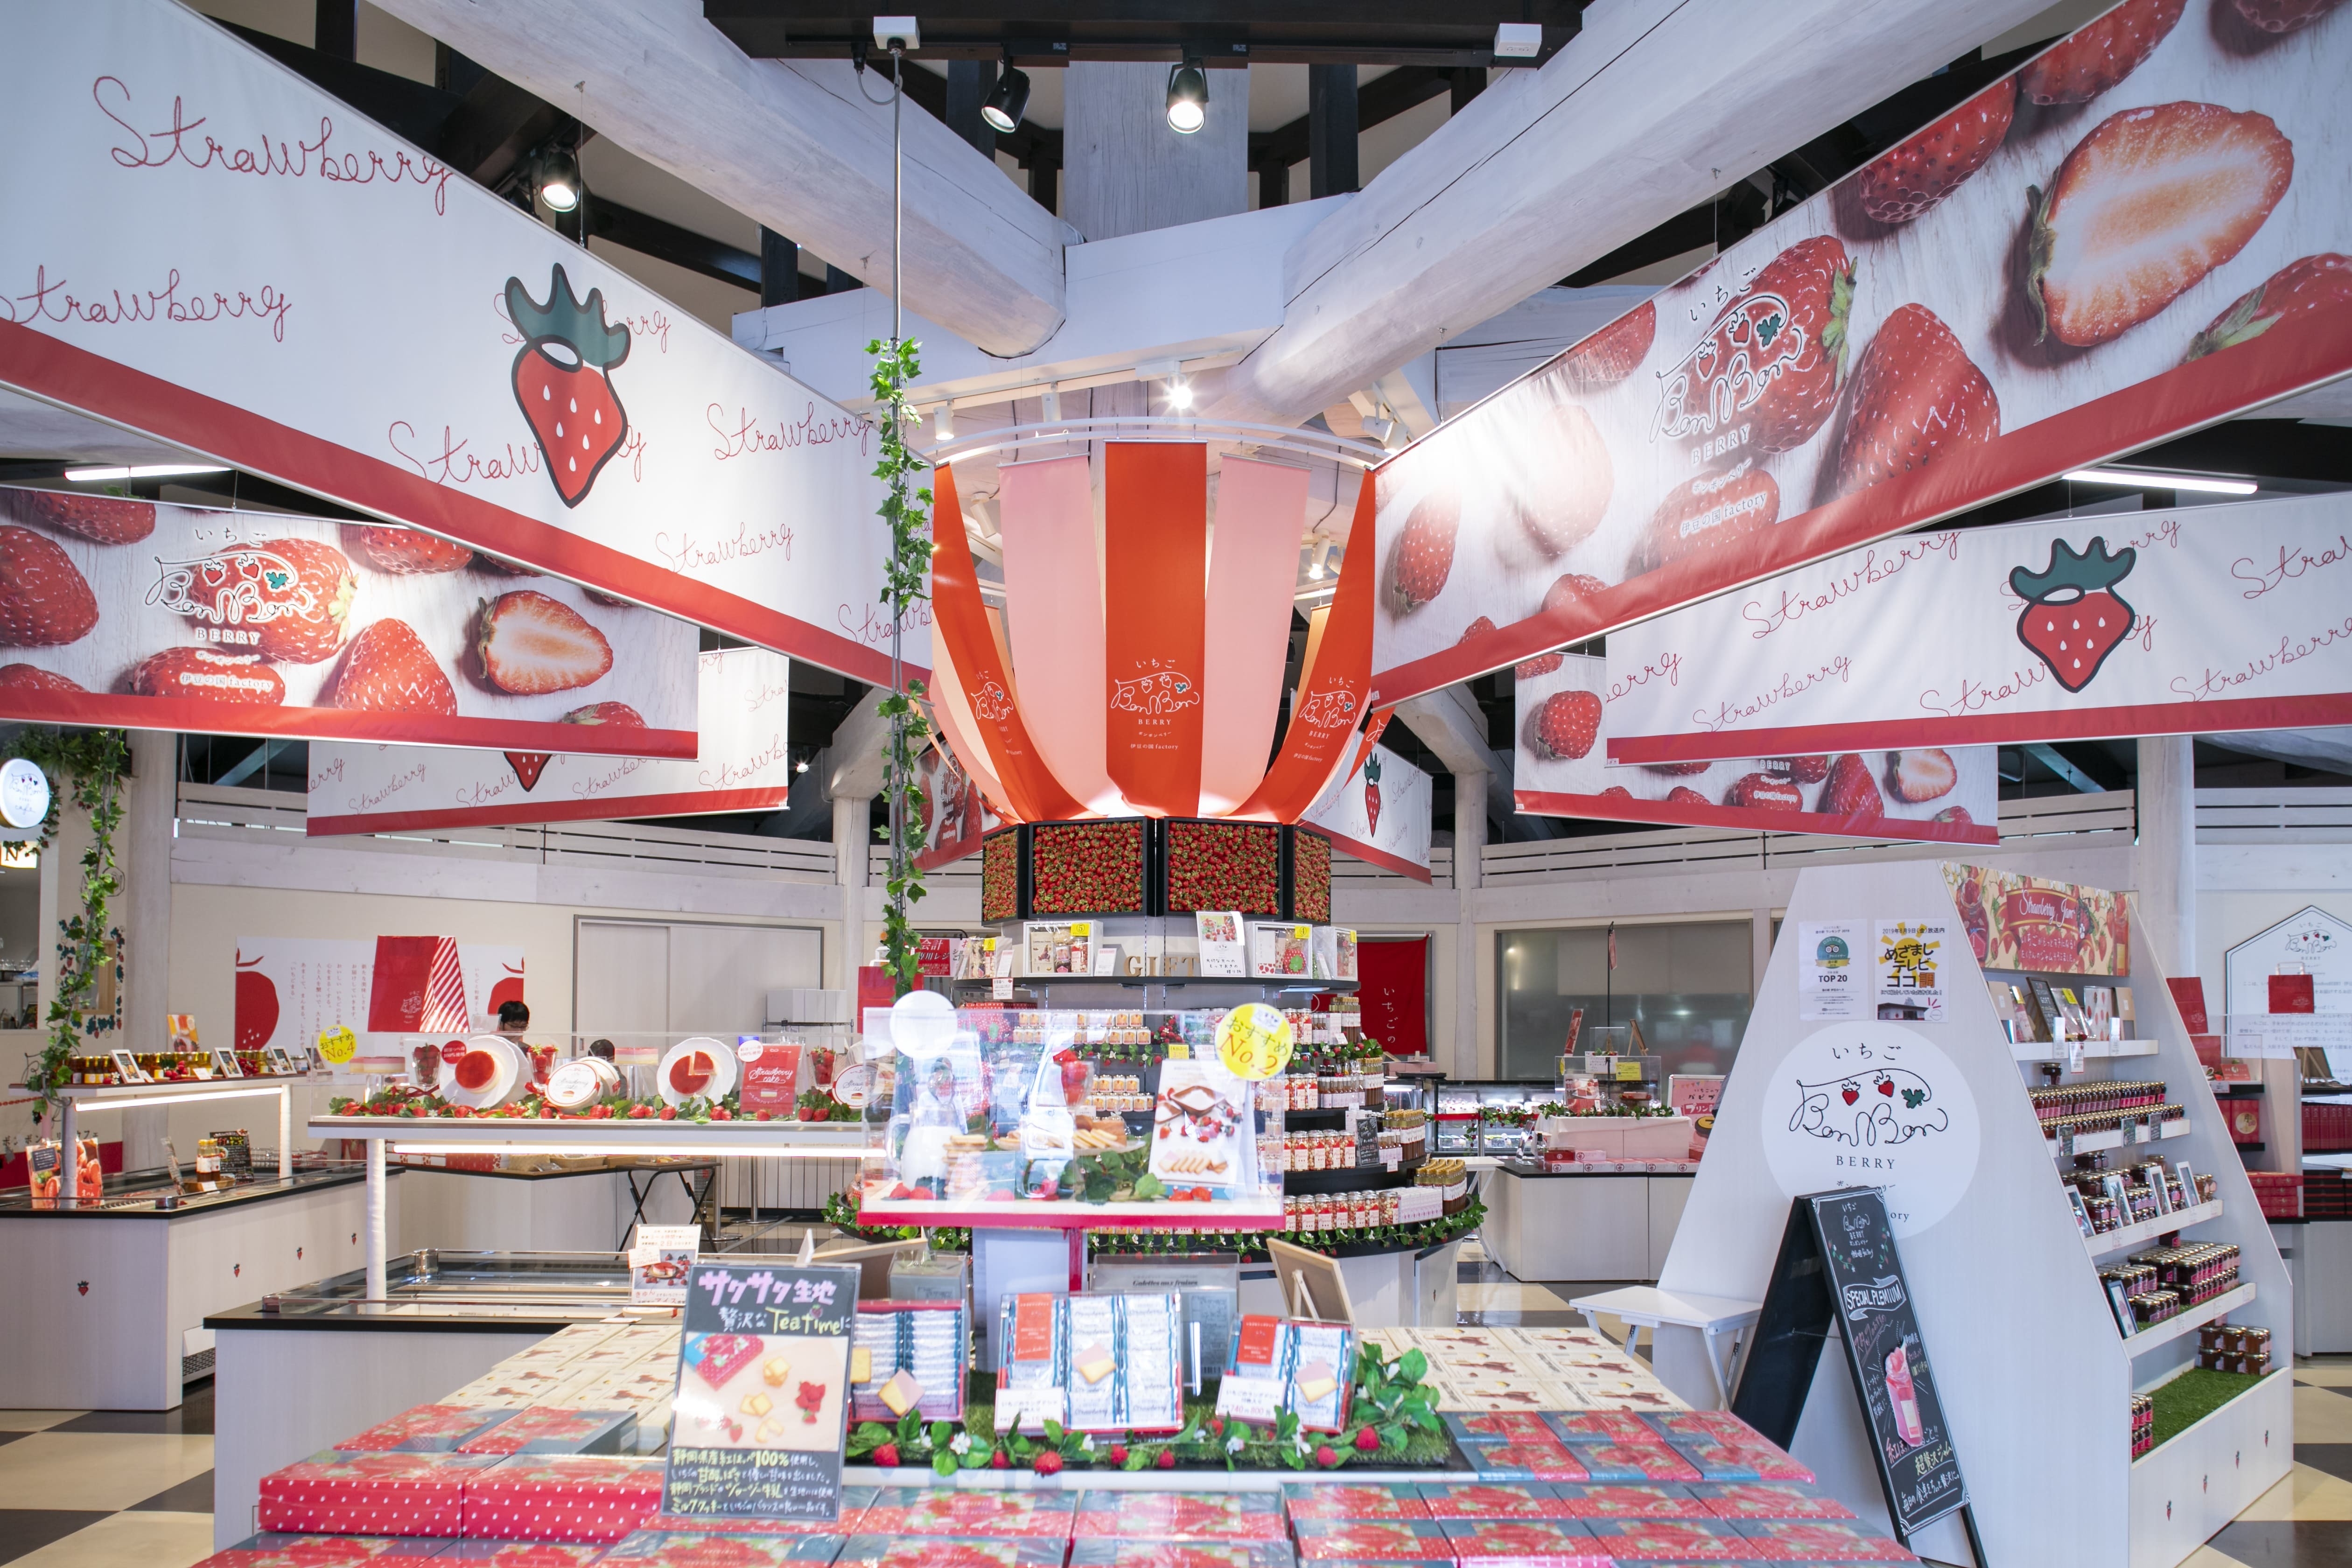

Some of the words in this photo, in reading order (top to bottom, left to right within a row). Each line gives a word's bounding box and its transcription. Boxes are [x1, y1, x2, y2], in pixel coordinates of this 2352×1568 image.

[94, 76, 453, 216] Strawberry
[1690, 267, 1757, 321] いちご
[1649, 294, 1803, 443] BonBon
[707, 402, 871, 460] Strawberry
[1692, 425, 1751, 465] BERRY
[389, 421, 646, 482] Strawy
[1681, 509, 1722, 536] 伊豆の国
[1724, 493, 1767, 519] factory
[195, 526, 266, 546] いちご
[656, 523, 794, 574] Strawberry
[145, 552, 312, 624] BonBon
[1743, 532, 1961, 638] Strawberry
[196, 629, 261, 644] BERRY
[1136, 658, 1176, 669] いちご
[229, 677, 274, 691] factory
[1111, 672, 1200, 714] BonBon
[1329, 676, 1354, 688] いちご
[1693, 656, 1852, 733] Strawberry
[1309, 730, 1330, 740] BERRY
[1761, 760, 1791, 770] BERRY
[348, 763, 426, 815] Strawberry
[1777, 792, 1797, 802] factory
[2019, 889, 2056, 924] Strawberry
[2056, 896, 2076, 927] Jam
[1123, 956, 1200, 977] GIFT
[1884, 943, 1934, 960] めざまし
[1892, 958, 1931, 973] テレビ
[1887, 972, 1935, 988] ココ調
[1381, 987, 1399, 1043] いちごの
[320, 1033, 354, 1050] おすすめ
[1227, 1016, 1288, 1057] おすすめ
[1833, 1043, 1901, 1061] いちご
[749, 1067, 793, 1080] Strawberry
[1789, 1068, 1948, 1147] BonBon
[1836, 1156, 1896, 1169] BERRY
[1842, 1202, 1856, 1212] いちご
[1849, 1230, 1864, 1240] BERRY
[698, 1270, 837, 1306] サクサク生地
[1846, 1288, 1873, 1310] SPECIAL
[1872, 1284, 1902, 1306] PLEMIUM
[1915, 1441, 1953, 1476] 超贅沢ジャム
